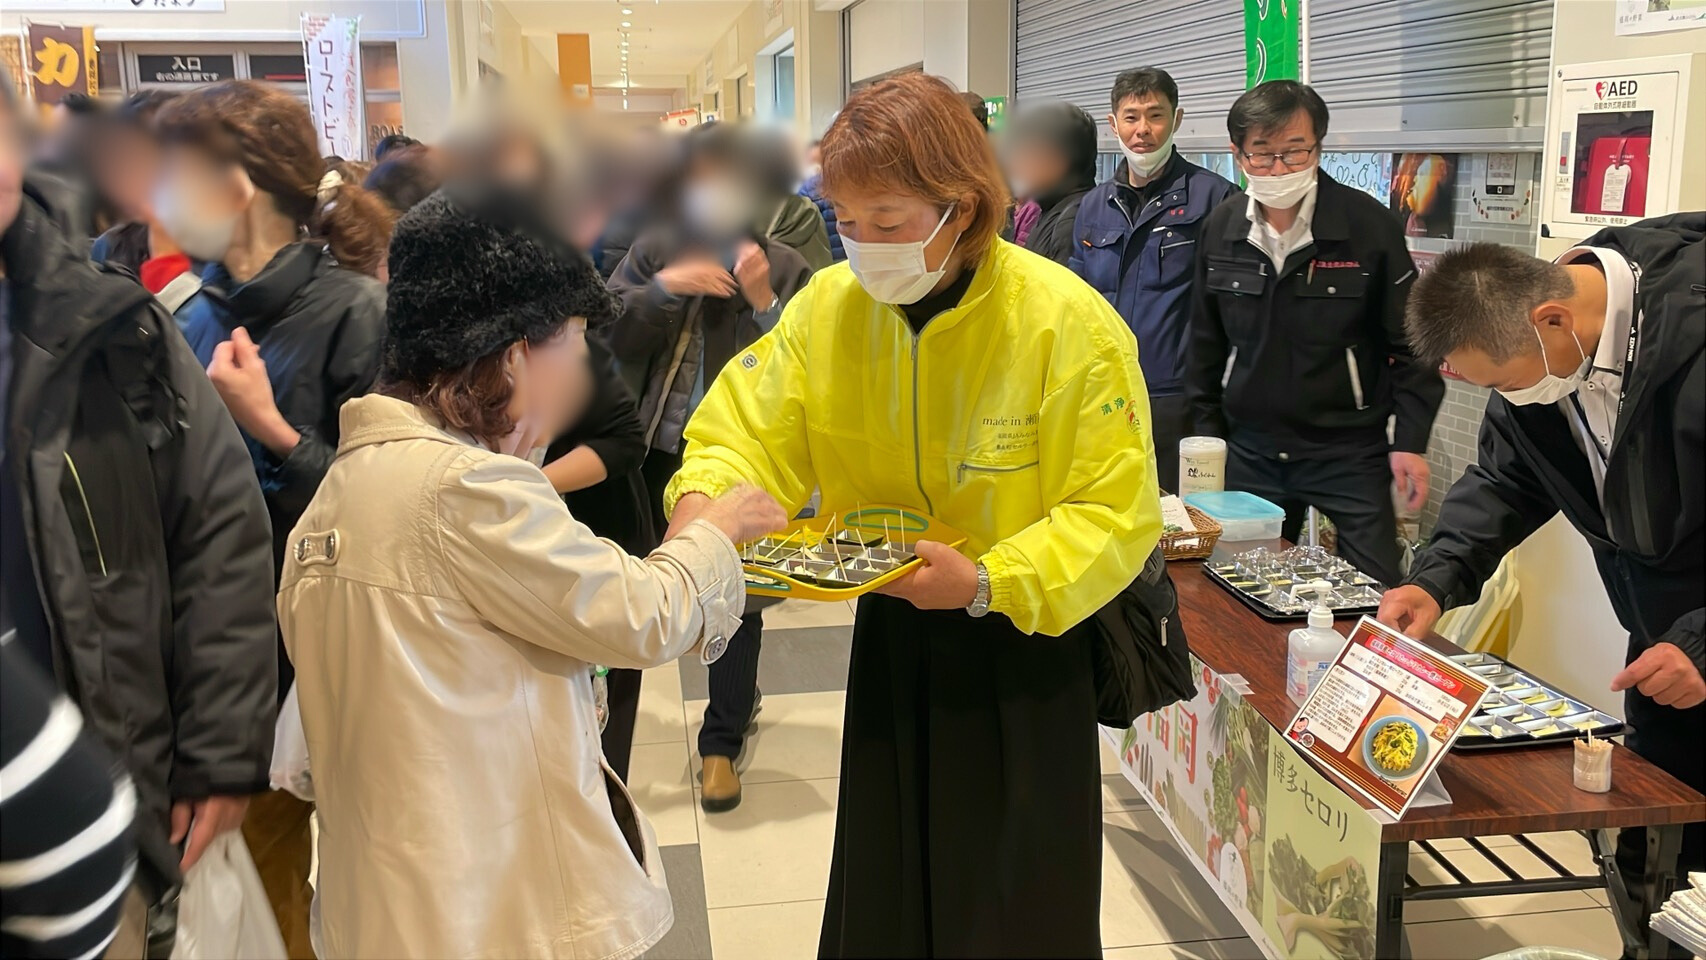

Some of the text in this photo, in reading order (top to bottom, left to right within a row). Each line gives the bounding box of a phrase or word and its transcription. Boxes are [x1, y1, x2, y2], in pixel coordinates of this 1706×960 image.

[171, 56, 202, 72] 入口
[1608, 80, 1638, 97] AED
[982, 416, 1008, 427] made
[1010, 415, 1021, 426] in
[1272, 744, 1349, 843] 博多セロリ
